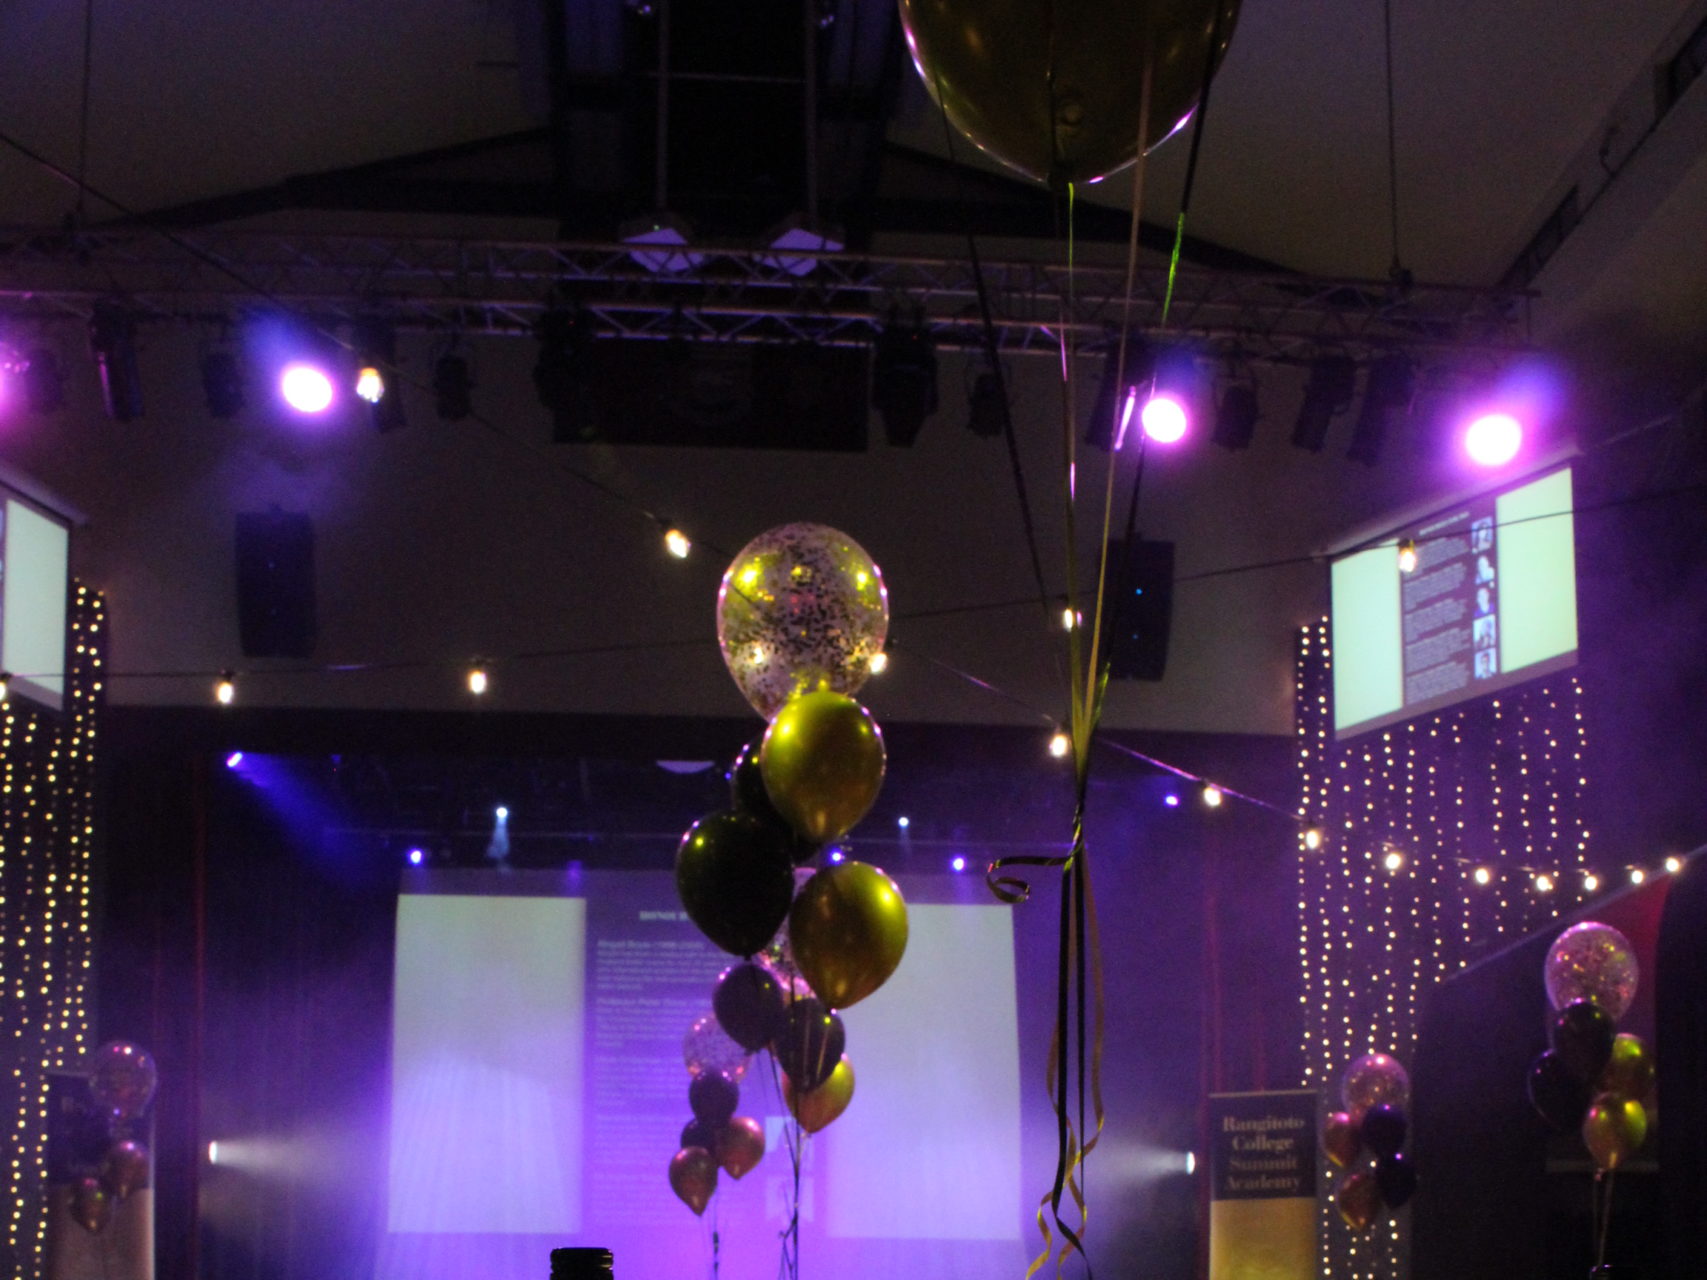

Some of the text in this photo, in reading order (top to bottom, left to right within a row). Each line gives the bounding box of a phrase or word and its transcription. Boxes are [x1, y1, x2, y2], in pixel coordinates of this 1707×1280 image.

[1223, 1115, 1305, 1132] Rangitoto
[1232, 1134, 1294, 1153] College
[1230, 1155, 1298, 1171] Summit
[1226, 1175, 1300, 1192] Academy
